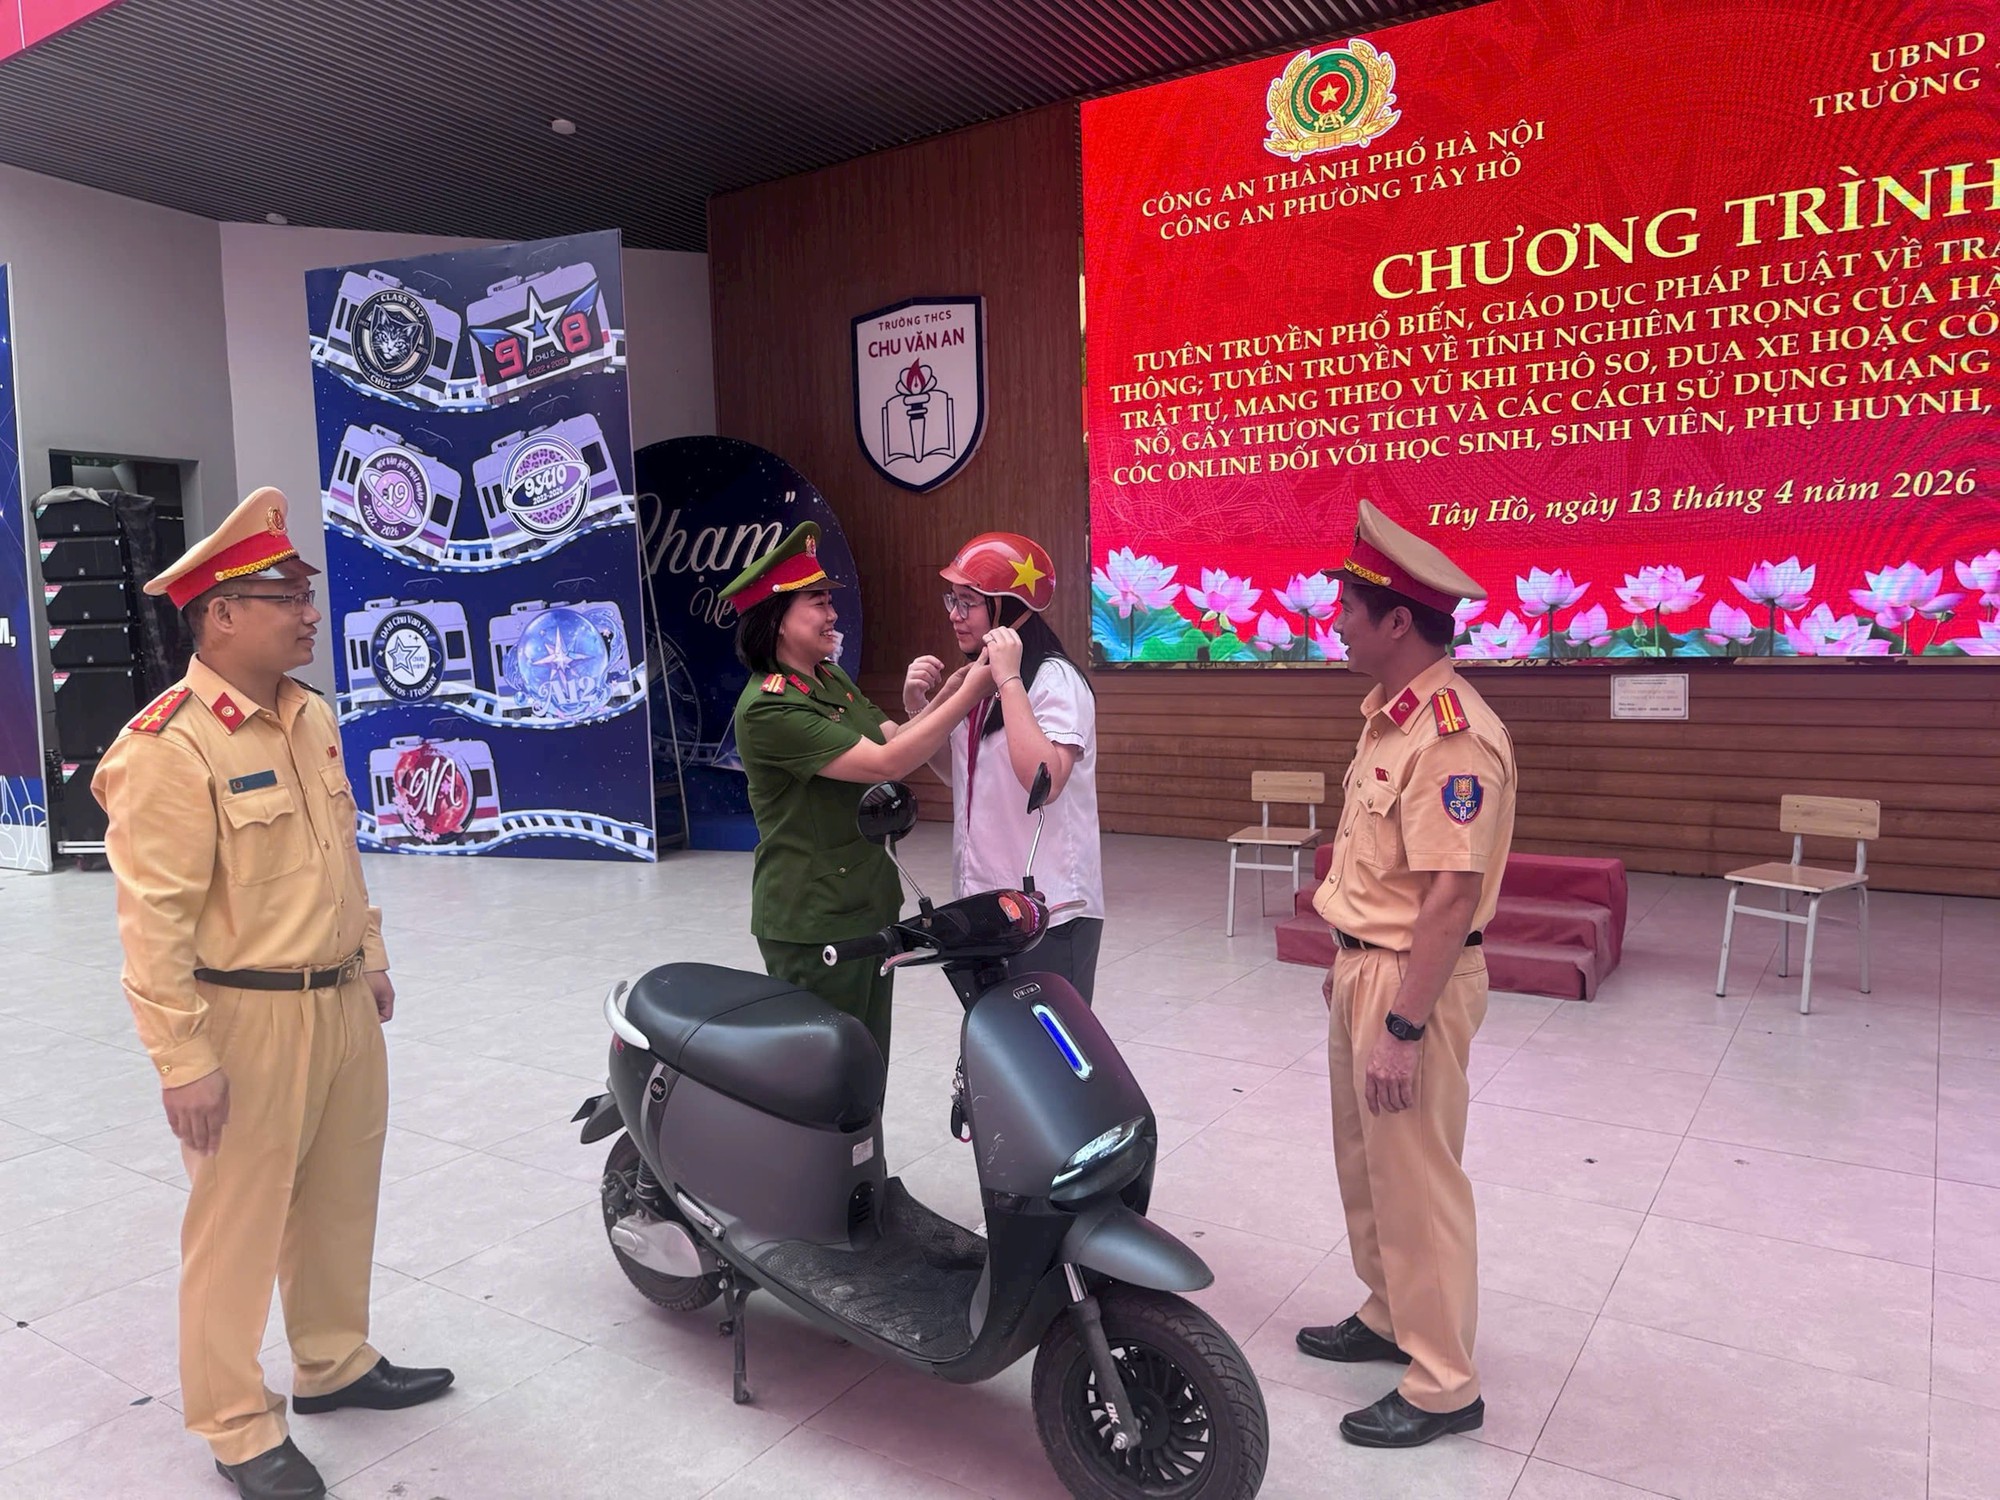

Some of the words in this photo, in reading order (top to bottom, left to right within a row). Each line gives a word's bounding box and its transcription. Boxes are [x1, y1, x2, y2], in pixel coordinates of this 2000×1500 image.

[1870, 32, 1986, 73] UBND
[1809, 67, 1981, 118] TRƯỜNG
[1141, 187, 1212, 218] CÔNG
[1220, 179, 1256, 202] AN
[1263, 156, 1360, 194] THÀNH
[1368, 136, 1427, 175] PHỐ
[1435, 131, 1479, 160] HÀ
[1488, 120, 1546, 154] NỘI
[1159, 210, 1231, 241] CÔNG
[1238, 203, 1275, 227] AN
[1283, 179, 1402, 219] PHƯỜNG
[1410, 164, 1466, 195] TÂY
[1476, 151, 1522, 181] HỒ
[1372, 207, 1701, 300] CHƯƠNG
[1725, 157, 2000, 248] TRÌNH
[380, 293, 409, 304] CLASS
[878, 315, 921, 332] TRƯỜNG
[925, 310, 952, 324] THCS
[1134, 341, 1213, 373] TUYÊN
[1219, 323, 1323, 361] TRUYỀN
[1330, 309, 1391, 346] PHỔ
[1398, 301, 1475, 337] BIẾN,
[1482, 291, 1565, 325] GIÁO
[1574, 281, 1646, 313] DỤC
[1655, 265, 1750, 302] PHÁP
[1760, 250, 1861, 288] LUẬT
[1872, 236, 1923, 272] VỀ
[868, 338, 901, 359] CHU
[905, 330, 937, 353] VĂN
[941, 327, 965, 348] AN
[1109, 374, 1204, 404] THÔNG;
[1210, 361, 1294, 391] TUYÊN
[1301, 342, 1413, 380] TRUYỀN
[1421, 333, 1459, 364] VỀ
[1466, 328, 1551, 359] TÍNH
[1555, 308, 1697, 348] NGHIÊM
[1705, 291, 1841, 329] TRỌNG
[1852, 277, 1938, 313] CỦA
[1120, 402, 1182, 432] TRẬT
[1188, 396, 1229, 427] TỰ,
[1234, 389, 1318, 418] MANG
[1325, 380, 1403, 407] THEO
[1411, 368, 1453, 398] VŨ
[1460, 366, 1518, 392] KHI
[1525, 351, 1596, 385] THÔ
[1604, 348, 1658, 376] SƠ,
[1667, 339, 1746, 369] ĐUA
[1756, 333, 1800, 360] XE
[1809, 316, 1929, 354] HOẶC
[1938, 301, 2000, 340] CỔ
[370, 374, 391, 389] CHU2
[528, 365, 546, 377] 2022
[1133, 425, 1176, 456] NỔ,
[1182, 424, 1234, 452] GÂY
[1240, 415, 1360, 446] THƯƠNG
[1367, 405, 1438, 433] TÍCH
[1446, 395, 1489, 424] VÀ
[1497, 388, 1563, 419] CÁC
[1570, 380, 1667, 412] CÁCH
[1676, 369, 1725, 401] SỬ
[1733, 363, 1848, 398] DỤNG
[1860, 349, 1991, 386] MẠNG
[1113, 461, 1163, 486] CÓC
[1168, 454, 1263, 482] ONLINE
[1268, 441, 1319, 473] ĐỐI
[1327, 438, 1378, 468] VỚI
[1385, 436, 1450, 464] HỌC
[1458, 428, 1543, 456] SINH,
[1550, 418, 1633, 448] SINH
[1641, 405, 1736, 438] VIÊN,
[1745, 401, 1828, 431] PHỤ
[1832, 387, 1993, 423] HUYNH,
[363, 504, 378, 526] 2022
[381, 525, 399, 536] 2026
[1427, 502, 1478, 530] Tây
[1486, 496, 1537, 525] Hồ,
[1544, 493, 1618, 523] ngày
[1627, 488, 1662, 514] 13
[1672, 483, 1764, 516] tháng
[1773, 480, 1794, 506] 4
[1803, 476, 1880, 503] năm
[1891, 467, 1977, 498] 2026
[1450, 800, 1461, 808] CS
[1465, 800, 1477, 808] GT
